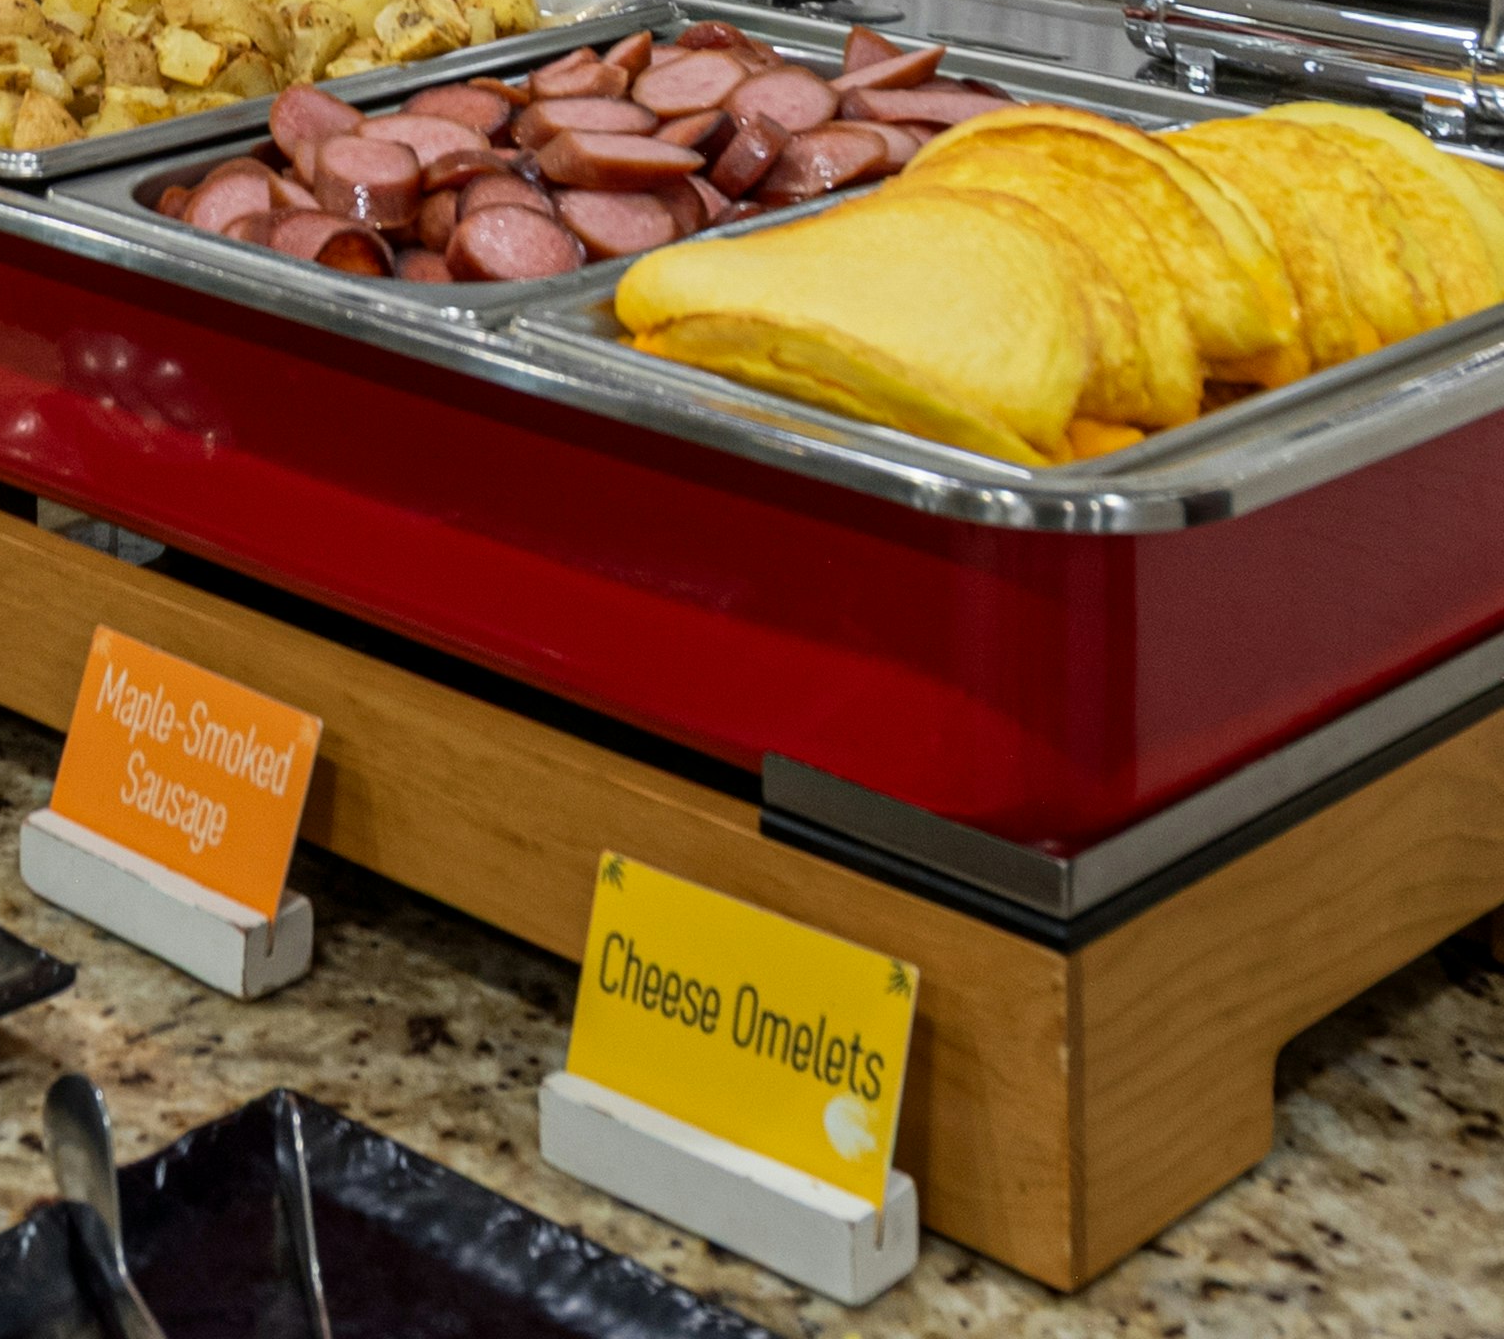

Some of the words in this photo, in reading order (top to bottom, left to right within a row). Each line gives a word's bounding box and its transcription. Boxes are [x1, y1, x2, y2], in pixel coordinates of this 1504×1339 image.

[95, 661, 296, 797] Maple-Smoked
[120, 750, 228, 854] Sausage
[599, 930, 721, 1034] Cheese
[731, 983, 885, 1103] Omelets
